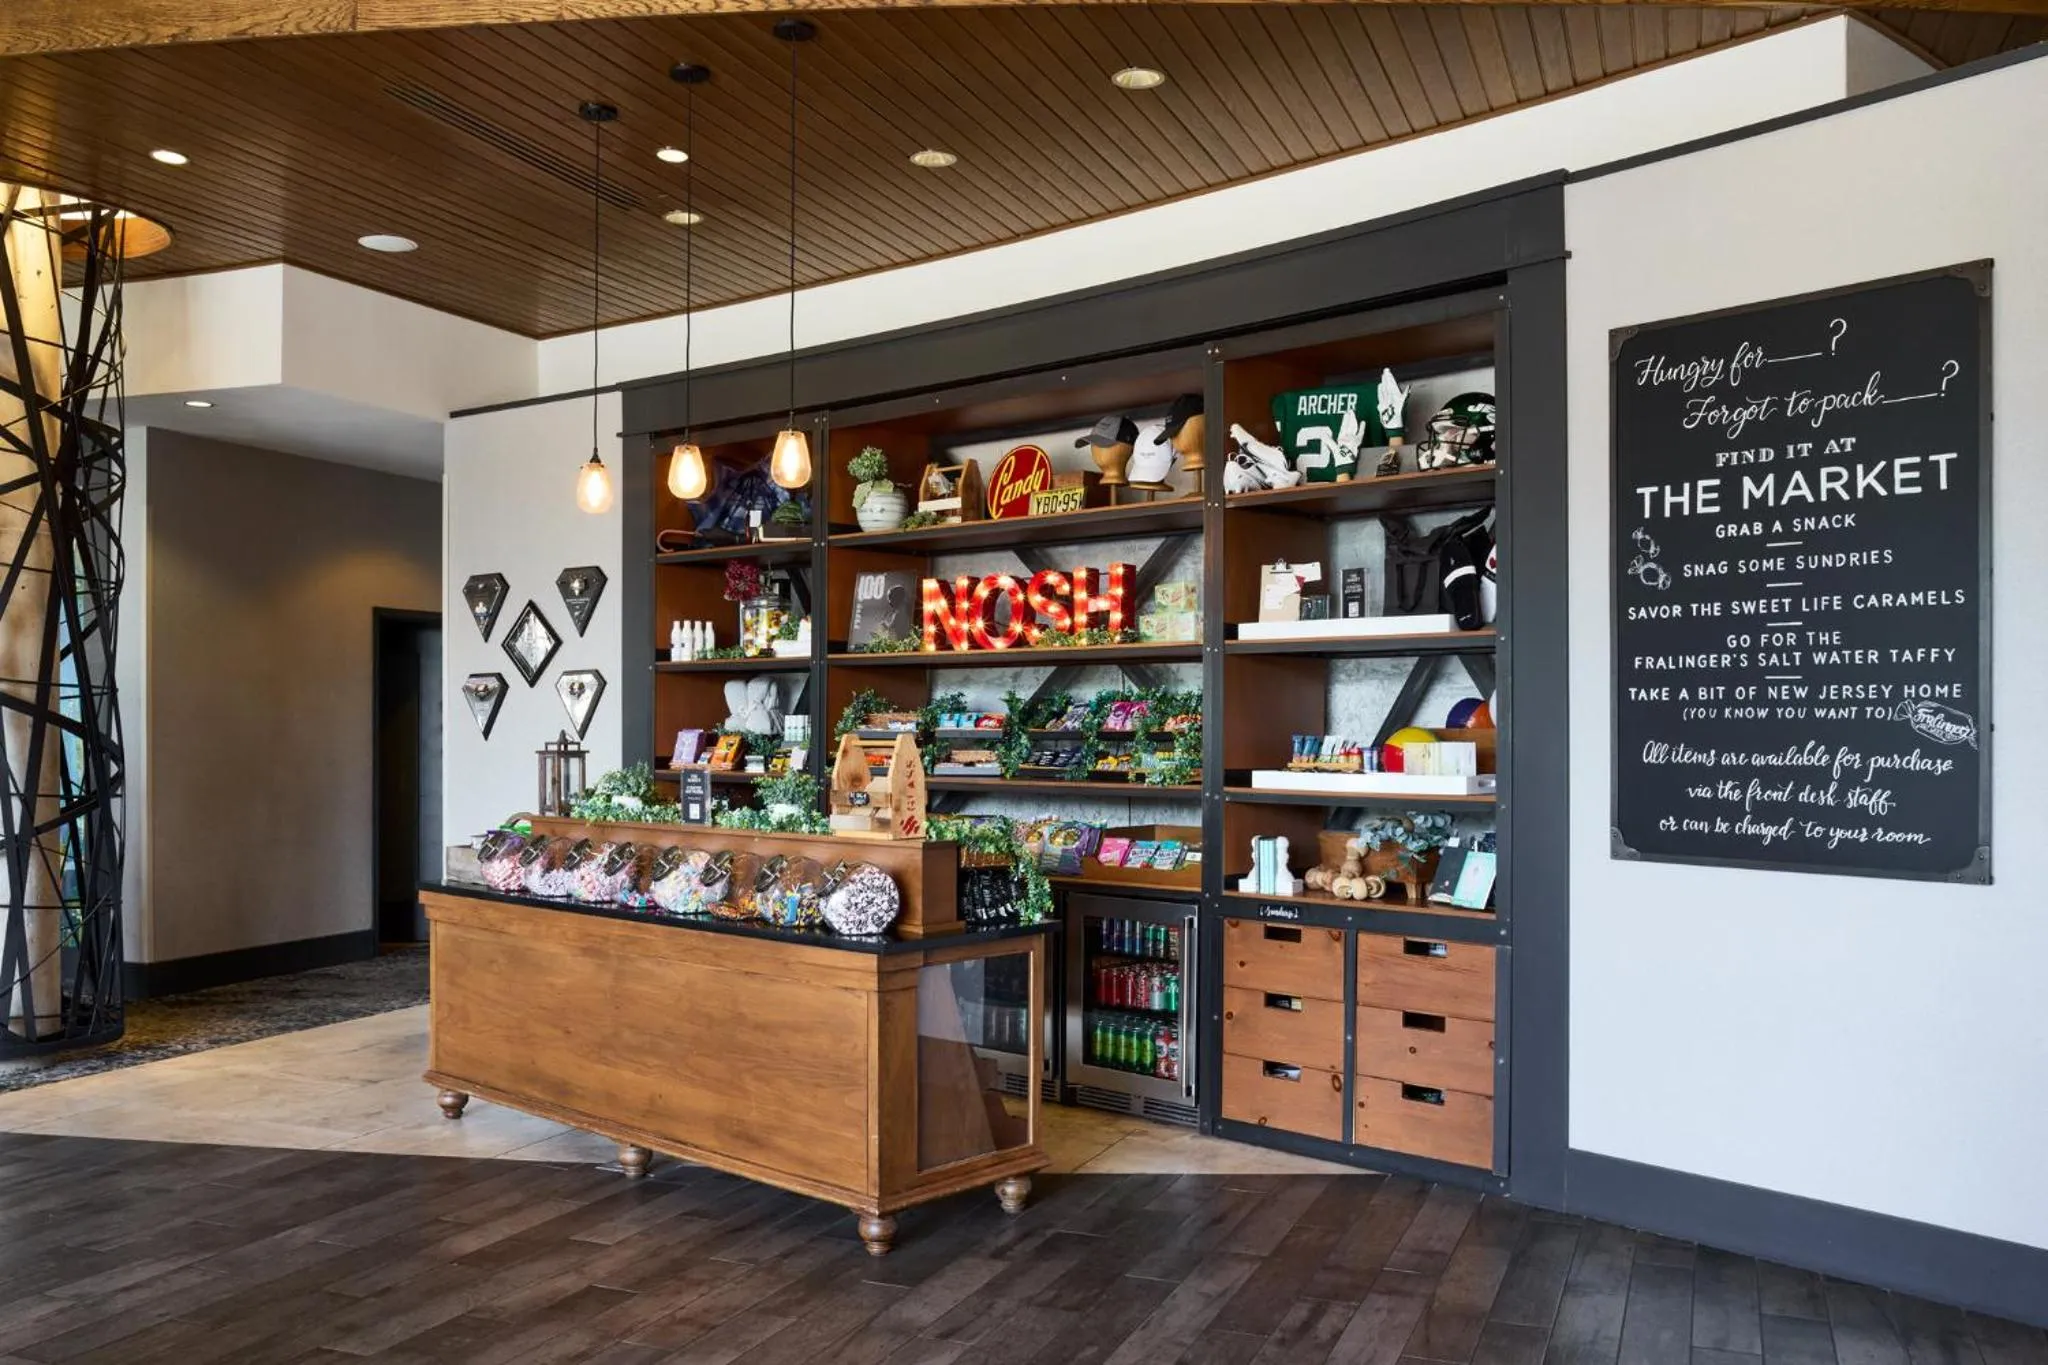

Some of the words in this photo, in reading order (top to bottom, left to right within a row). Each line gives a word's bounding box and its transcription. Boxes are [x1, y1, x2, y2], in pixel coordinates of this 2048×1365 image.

[1634, 355, 1724, 393] Hungry
[1730, 341, 1768, 387] for
[1296, 393, 1358, 416] ARCHER
[1682, 395, 1778, 439] Forgot
[1784, 390, 1815, 417] to
[1811, 371, 1885, 428] pack
[1715, 447, 1775, 468] FIND
[1786, 442, 1813, 460] IT
[1823, 437, 1856, 454] AT
[992, 450, 1046, 520] Candy
[1636, 478, 1721, 519] THE
[1742, 452, 1958, 511] MARKET
[1715, 521, 1763, 539] GRAB
[1771, 520, 1783, 534] A
[1792, 513, 1857, 532] SNACK
[1683, 560, 1729, 578] SNAG
[1737, 557, 1786, 574] SOME
[1795, 549, 1894, 570] SUNDRIES
[922, 564, 1137, 652] NOSH
[1628, 604, 1683, 621] SAVOR
[1690, 602, 1722, 617] THE
[1731, 598, 1793, 616] SWEET
[1801, 595, 1843, 612] LIFE
[1853, 588, 1966, 610] CARAMELS
[1726, 634, 1751, 649] GO
[1760, 632, 1797, 648] FOR
[1805, 631, 1842, 646] THE
[1634, 653, 1749, 670] FRALINGER'S
[1758, 651, 1802, 667] SALT
[1812, 650, 1880, 665] WATER
[1889, 648, 1956, 663] TAFFY
[1628, 687, 1671, 701] TAKE
[1678, 687, 1690, 701] A
[1698, 686, 1726, 701] BIT
[1735, 686, 1758, 700] OF
[1767, 685, 1809, 700] NEW
[1818, 684, 1894, 700] JERSEY
[1903, 683, 1963, 699] HOME
[1682, 707, 1718, 721] (YOU
[1724, 706, 1770, 720] KNOW
[1776, 706, 1807, 720] YOU
[1813, 706, 1858, 720] WANT
[1865, 706, 1893, 721] TO)
[1642, 740, 1668, 765] All
[1671, 742, 1717, 767] items
[1721, 752, 1750, 766] are
[1751, 740, 1831, 767] available
[1833, 746, 1862, 780] for
[1864, 748, 1954, 783] purchase
[1686, 784, 1714, 799] via
[1716, 779, 1743, 801] the
[1745, 778, 1795, 812] front
[1798, 781, 1841, 806] desk
[1845, 786, 1896, 816] staff
[1659, 815, 1678, 832] or
[1682, 818, 1710, 834] can
[1714, 816, 1730, 834] be
[1735, 814, 1796, 846] charged
[1799, 821, 1827, 838] to
[1827, 827, 1869, 850] your
[1870, 827, 1932, 845] room
